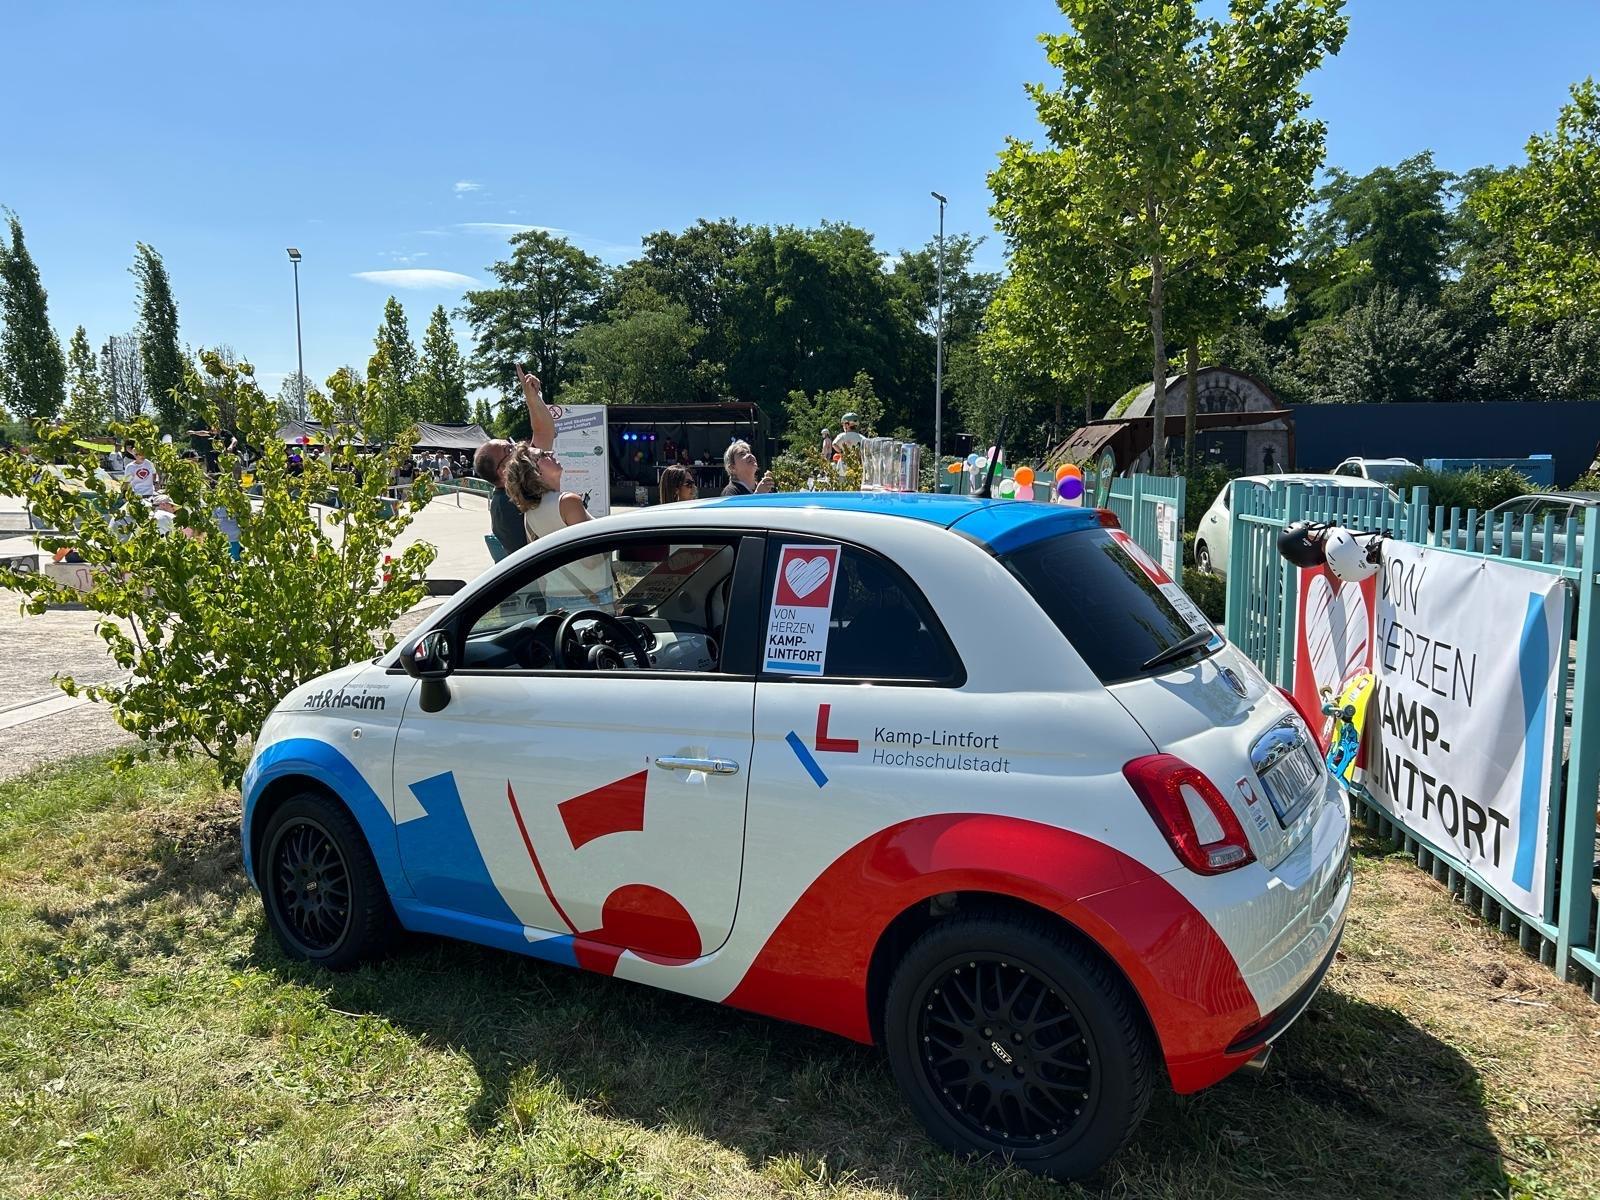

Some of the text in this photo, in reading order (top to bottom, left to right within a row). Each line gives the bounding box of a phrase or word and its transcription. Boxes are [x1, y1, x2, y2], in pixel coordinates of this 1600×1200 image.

[1383, 556, 1427, 616] VON
[773, 608, 797, 620] VON
[770, 621, 815, 635] HERZEN
[769, 634, 807, 647] KAMP-
[767, 647, 823, 662] LINTFORT
[1375, 613, 1477, 708] HERZEN
[1371, 675, 1451, 757] KAMP-
[874, 727, 999, 749] Kamp-Lintfort
[872, 749, 1010, 774] Hochschulstadt
[1370, 737, 1510, 868] LINTFORT
